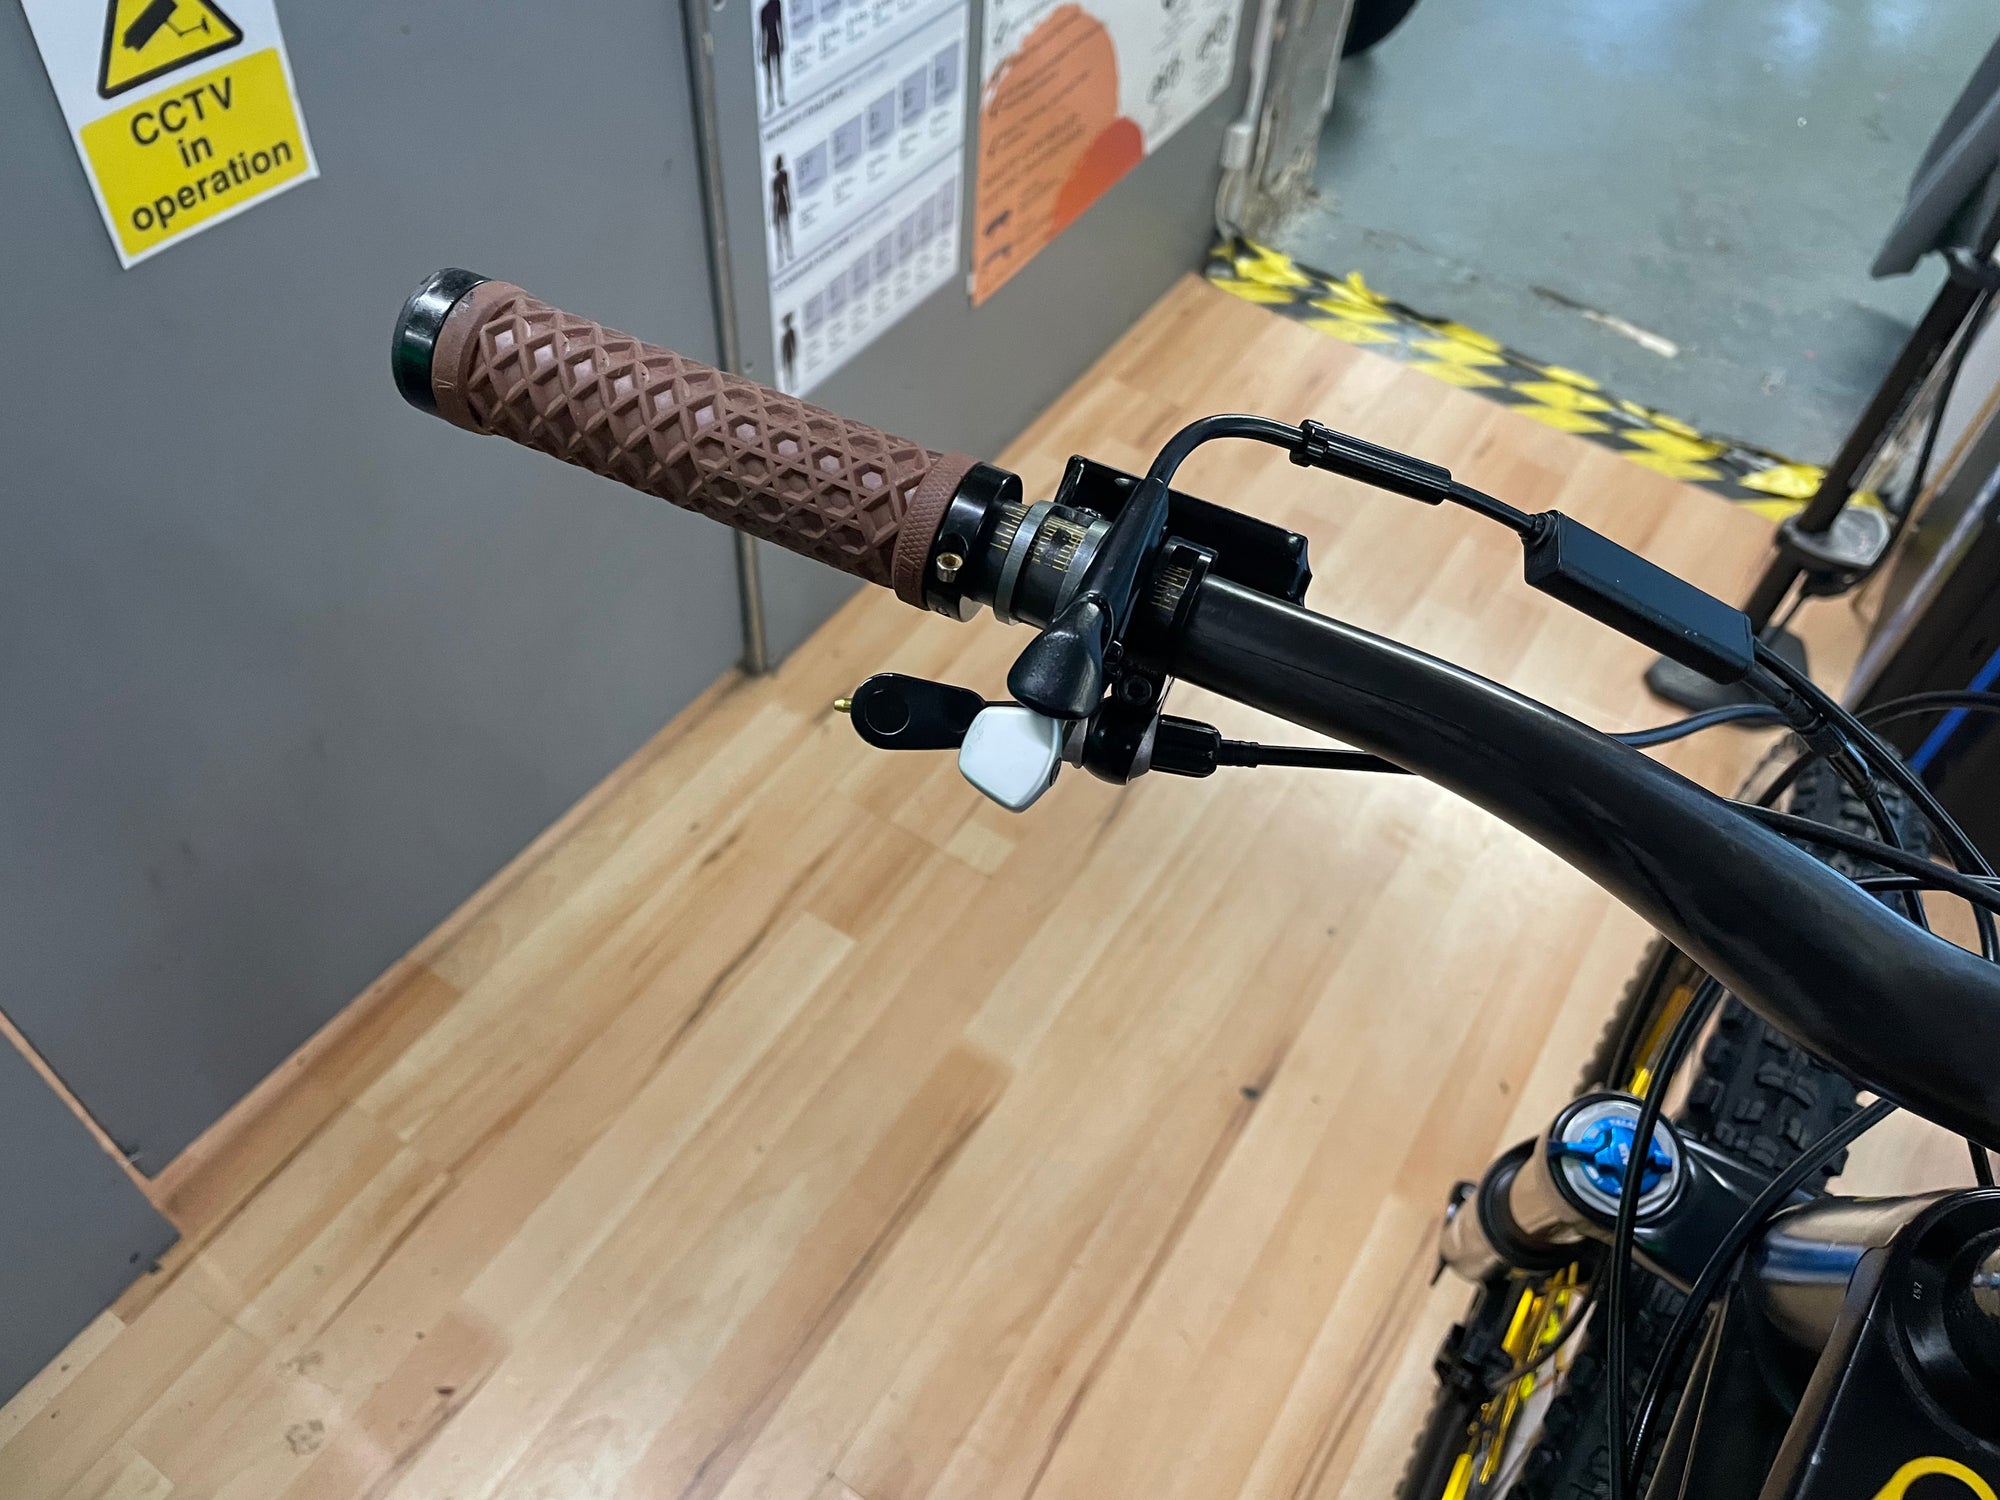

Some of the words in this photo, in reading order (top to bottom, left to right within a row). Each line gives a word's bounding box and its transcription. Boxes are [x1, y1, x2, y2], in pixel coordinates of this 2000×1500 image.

[131, 77, 232, 146] CCTV
[132, 141, 292, 230] operation
[178, 137, 212, 168] in
